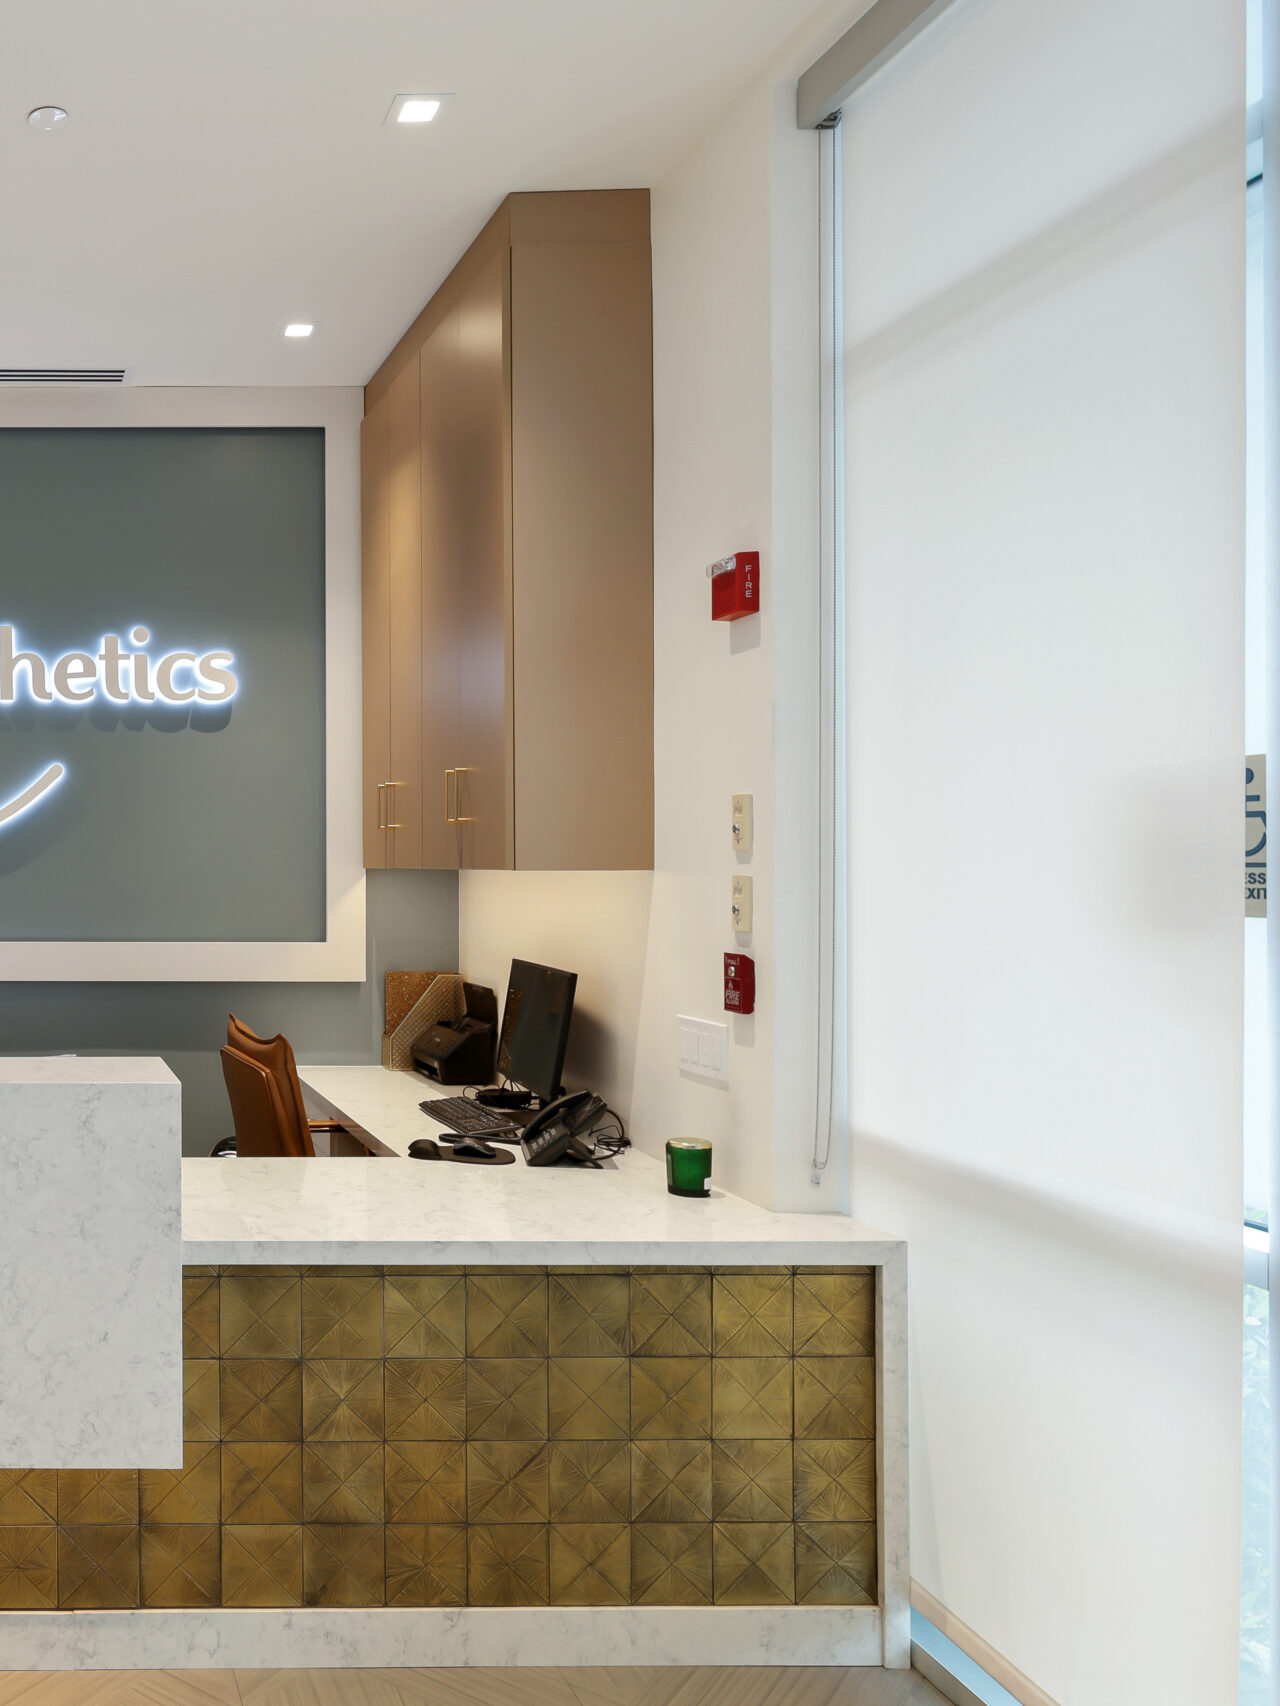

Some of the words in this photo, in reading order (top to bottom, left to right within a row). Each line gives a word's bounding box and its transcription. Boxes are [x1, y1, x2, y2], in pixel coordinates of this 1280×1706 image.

[745, 564, 753, 598] FIRE
[1245, 887, 1267, 900] XIT
[725, 989, 741, 1001] FIRE
